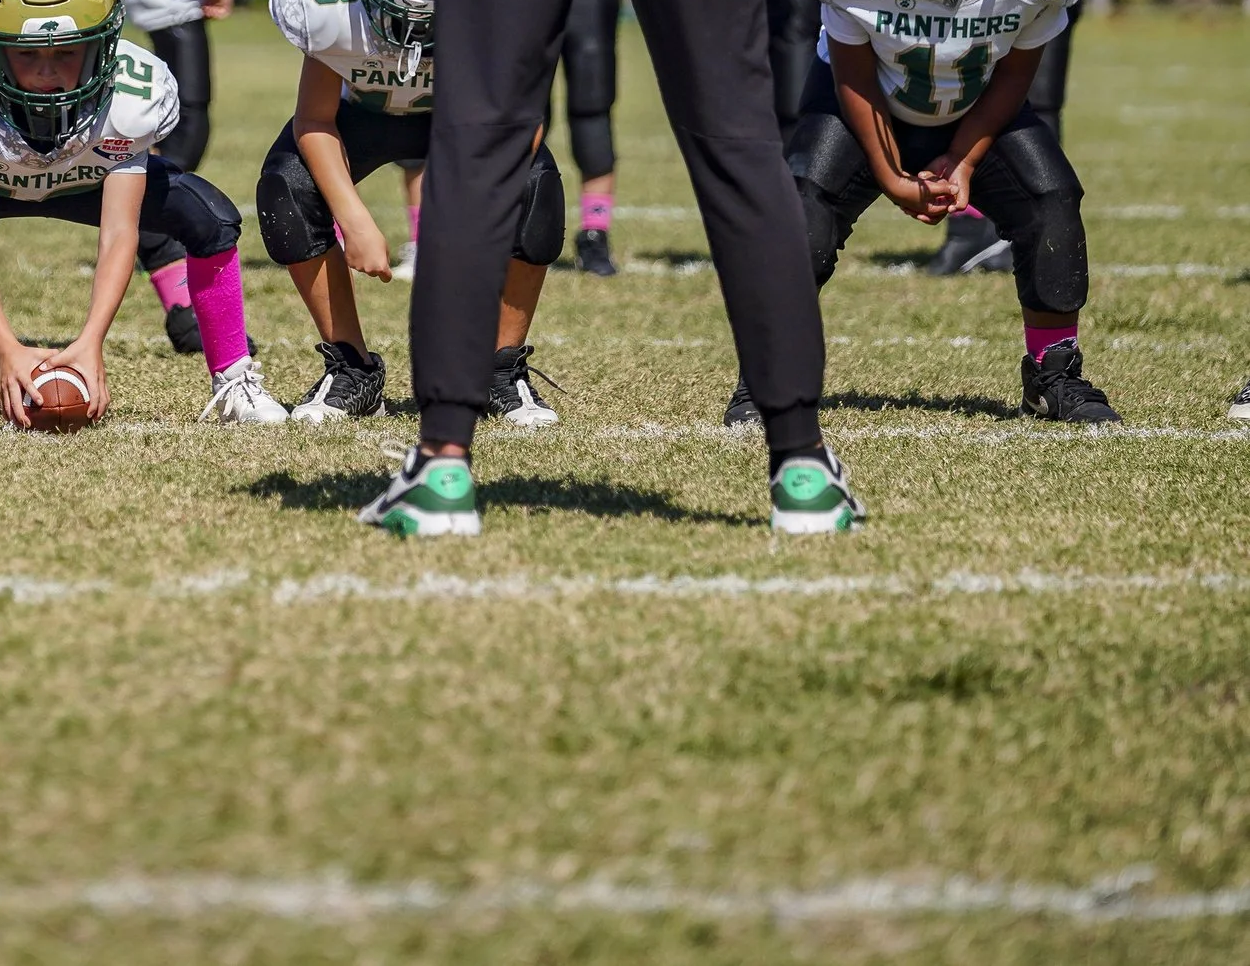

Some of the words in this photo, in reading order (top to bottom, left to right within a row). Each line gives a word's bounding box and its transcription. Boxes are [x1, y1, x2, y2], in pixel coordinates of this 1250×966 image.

[875, 9, 1021, 39] PANTHERS
[112, 52, 154, 101] 12
[893, 40, 993, 117] 11
[104, 138, 134, 146] POP
